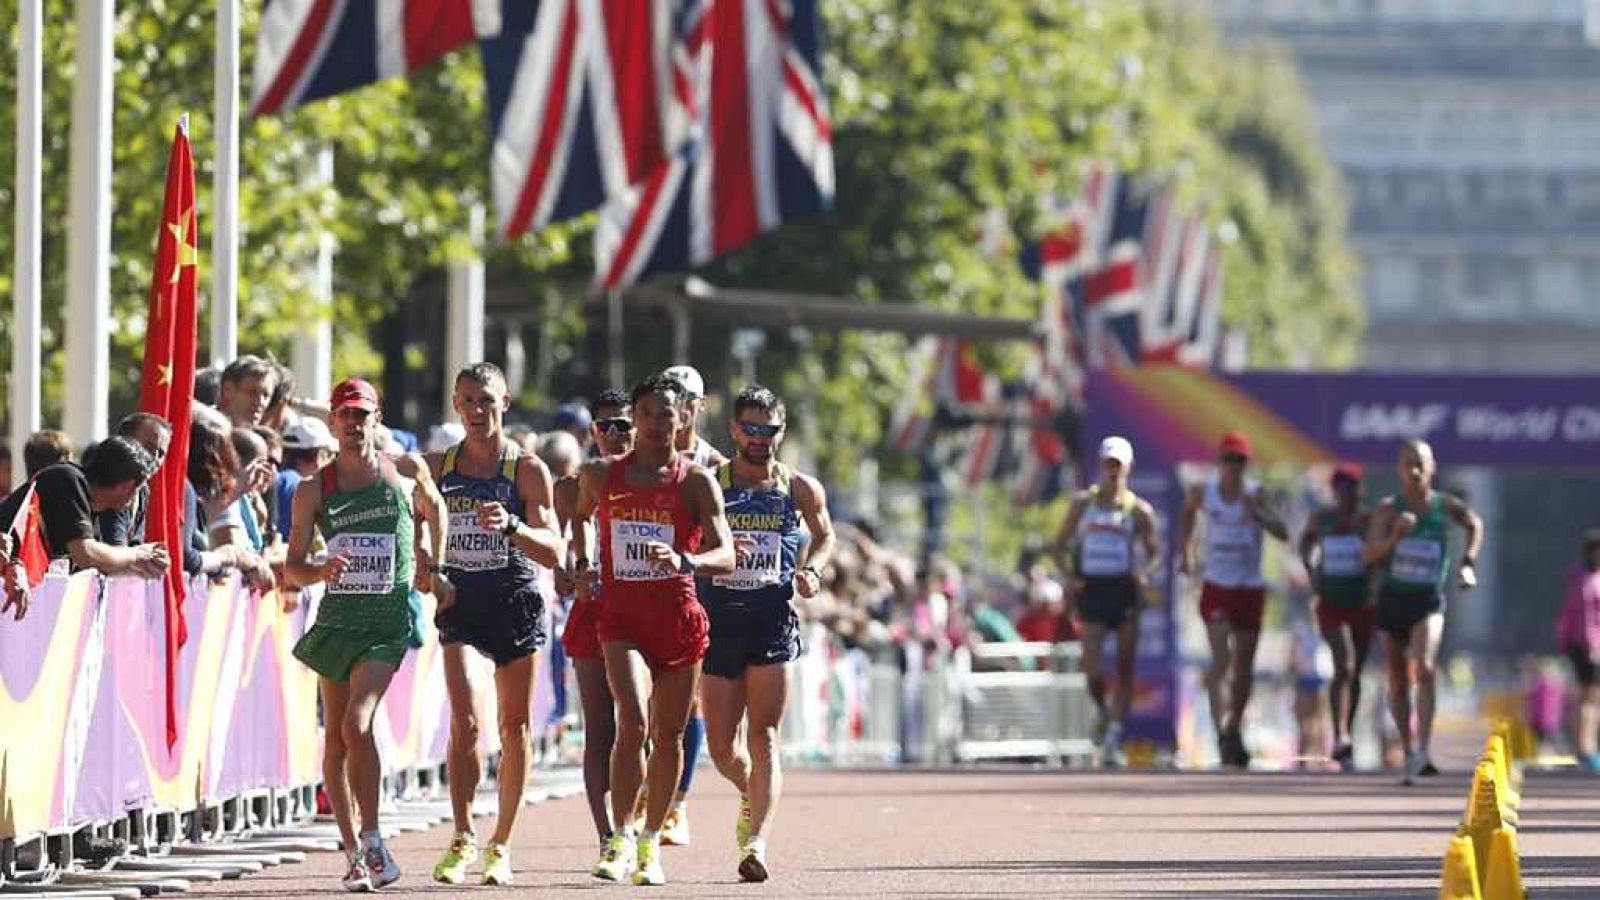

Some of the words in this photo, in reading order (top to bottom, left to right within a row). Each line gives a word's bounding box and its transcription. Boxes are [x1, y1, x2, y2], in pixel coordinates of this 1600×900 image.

[1456, 405, 1558, 441] World
[632, 525, 662, 537] TDK
[350, 537, 385, 547] TDK
